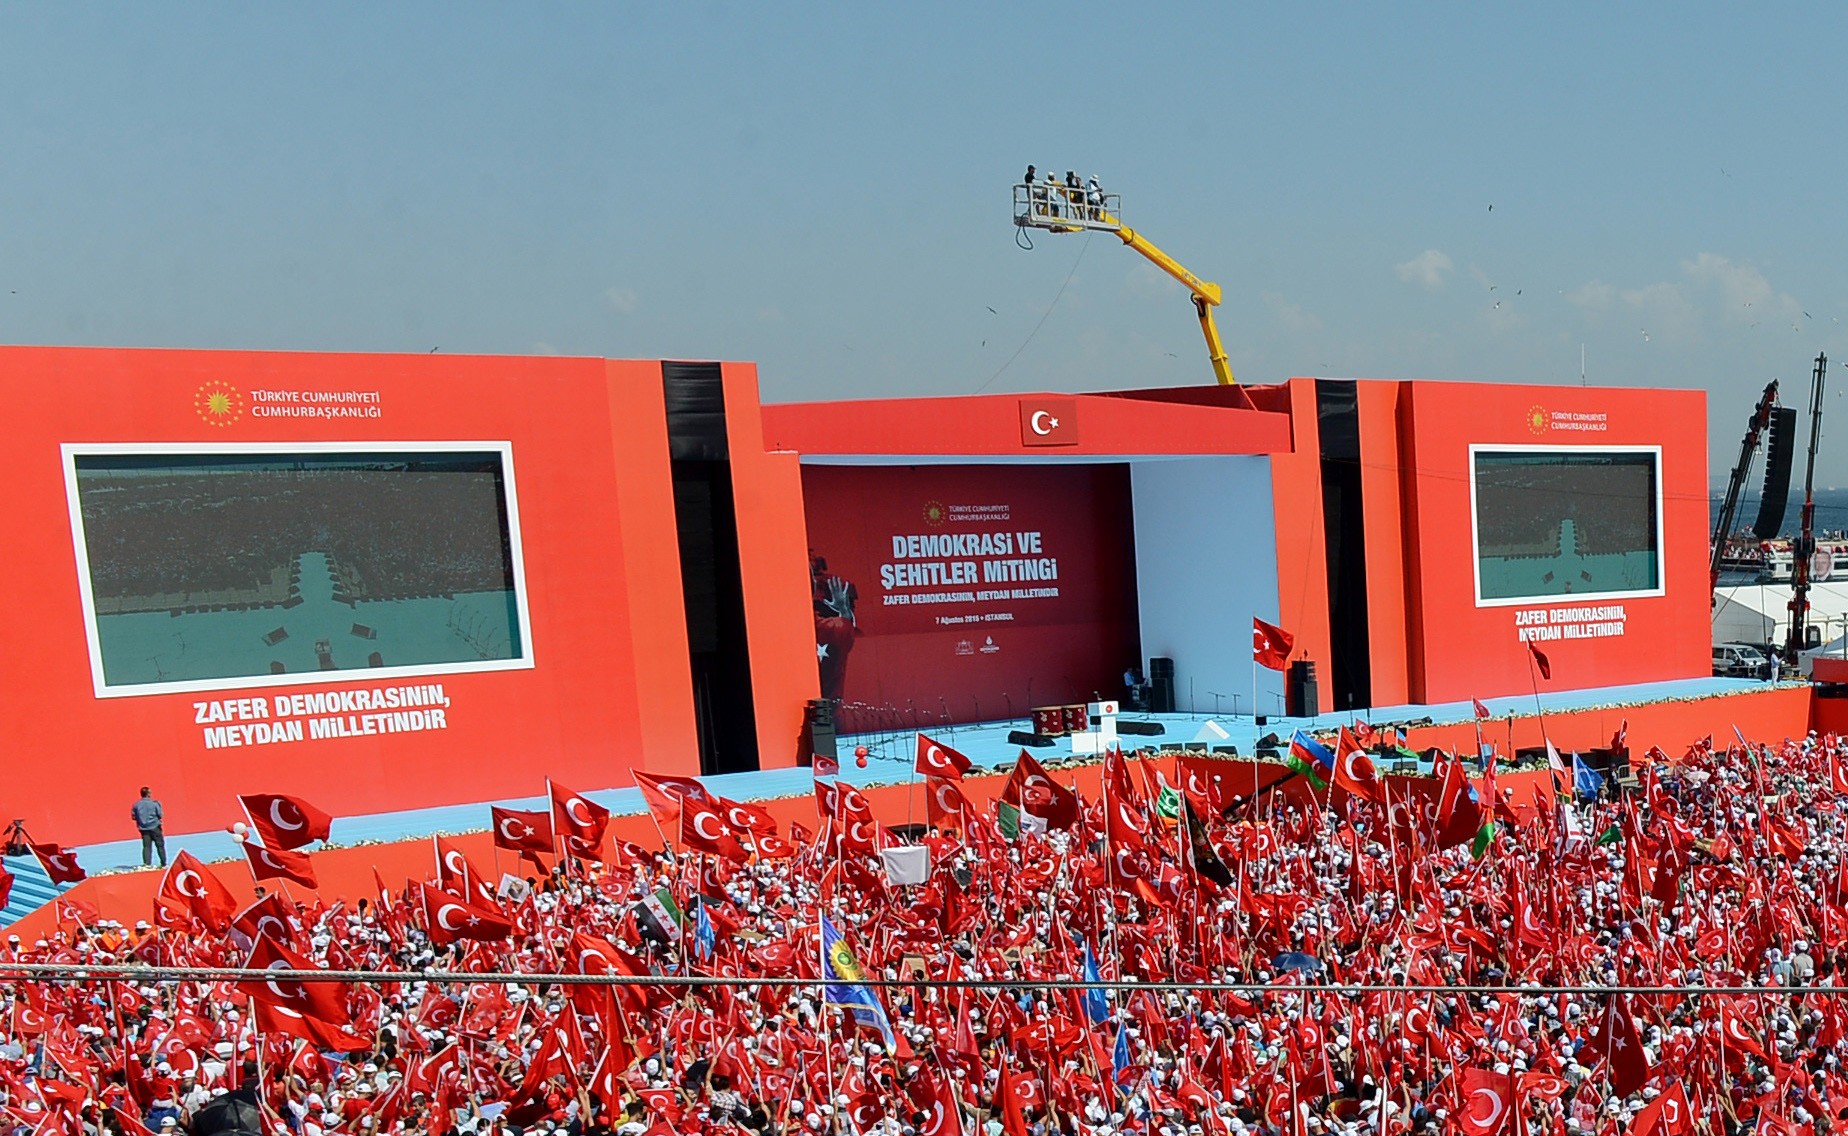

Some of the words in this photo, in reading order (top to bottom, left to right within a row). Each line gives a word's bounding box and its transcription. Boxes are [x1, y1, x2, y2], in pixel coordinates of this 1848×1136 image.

[251, 389, 299, 403] TÜRKİYE
[302, 391, 380, 404] CUMHURİYETİ
[251, 406, 381, 420] CUMHURBAŞKANLIĞI
[1551, 411, 1572, 421] TÜRKİYE
[1573, 412, 1607, 422] CUMHURİYETİ
[1551, 422, 1607, 432] CUMHURBAŞKANLIĞI
[1016, 532, 1043, 554] VE
[883, 595, 910, 605] ZAFER
[977, 589, 1010, 601] MEYDAN
[1515, 609, 1548, 626] ZAFER
[1518, 626, 1562, 642] MEYDAN
[193, 697, 269, 724] ZAFER
[203, 720, 304, 749] MEYDAN
